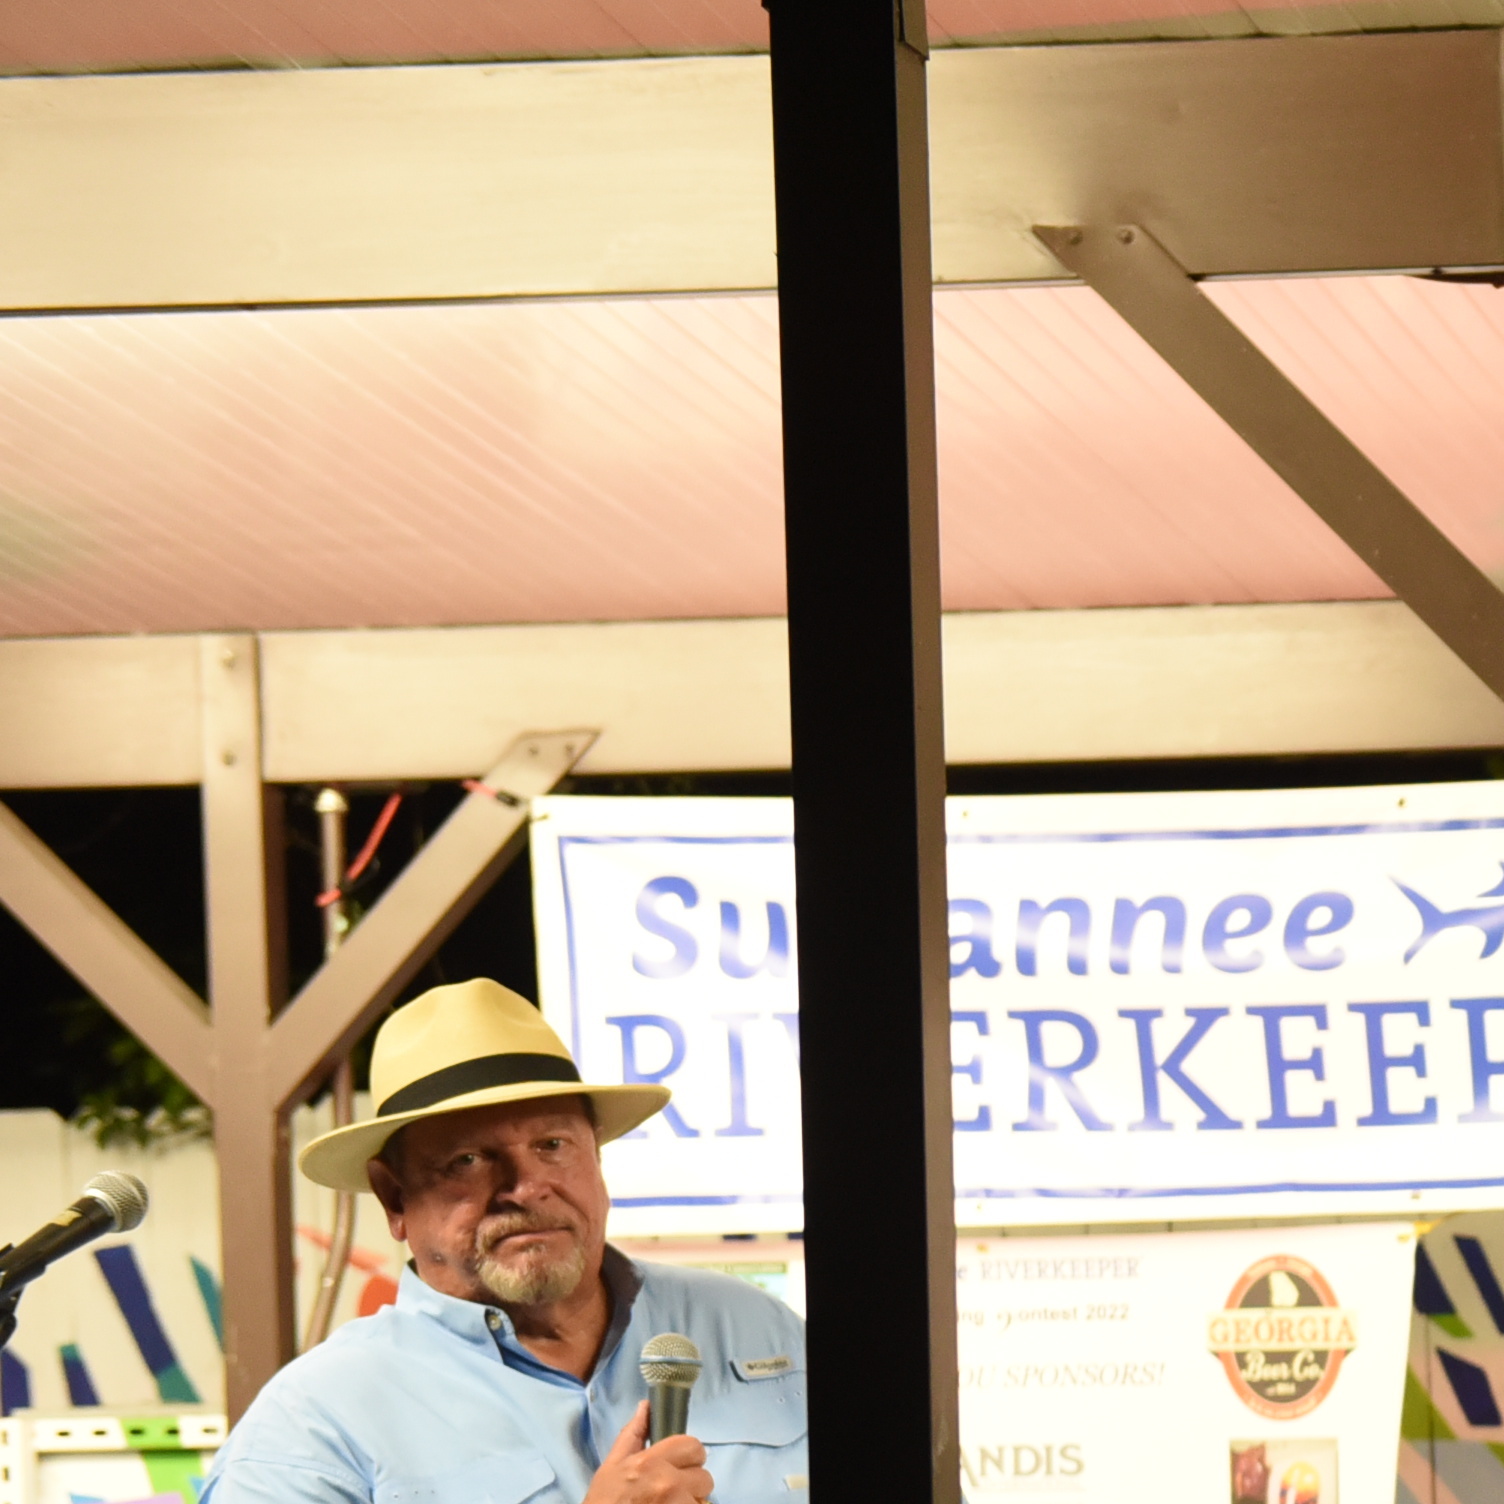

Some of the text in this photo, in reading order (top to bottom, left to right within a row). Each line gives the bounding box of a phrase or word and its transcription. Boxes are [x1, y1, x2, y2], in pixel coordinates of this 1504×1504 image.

[632, 875, 1354, 980] Suannee
[980, 1257, 1140, 1280] RIVERKEEPER
[1086, 1303, 1130, 1321] 2022
[1208, 1315, 1357, 1345] GEORGIA
